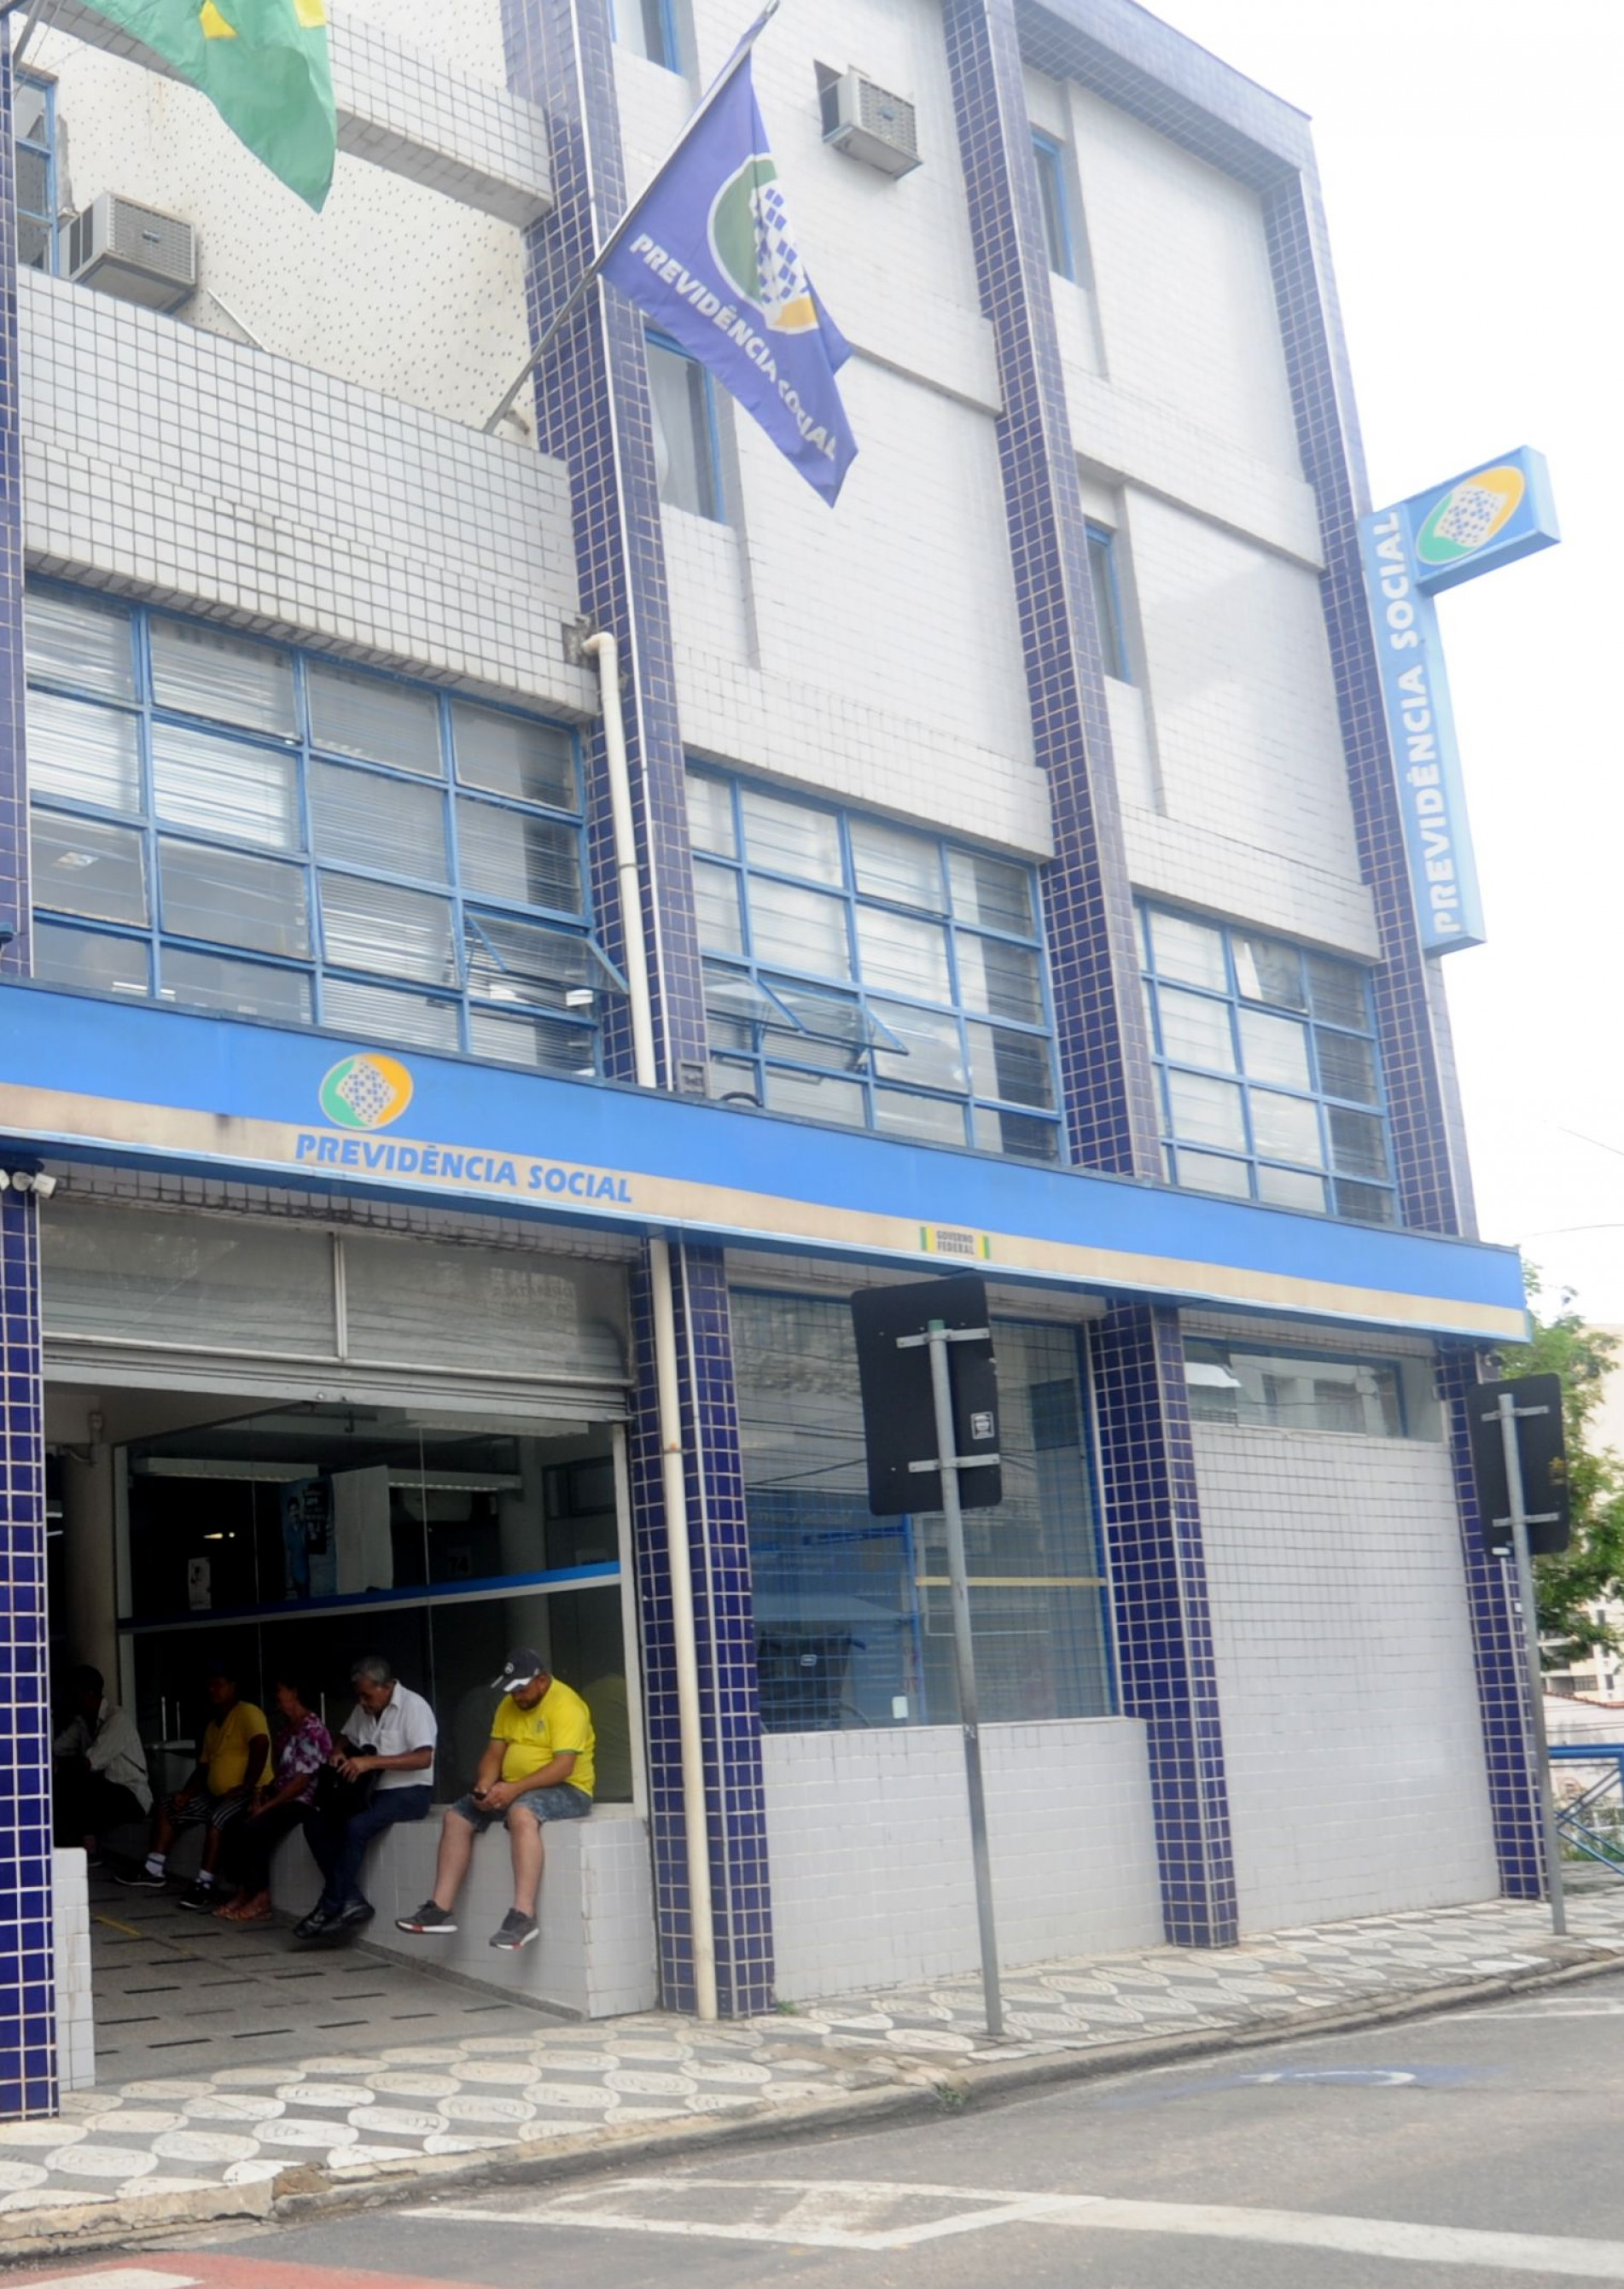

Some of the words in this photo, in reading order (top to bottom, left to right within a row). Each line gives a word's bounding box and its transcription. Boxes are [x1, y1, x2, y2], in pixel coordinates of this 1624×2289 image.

[629, 234, 777, 383] PREVIDÊNCIA
[1373, 511, 1418, 651] SOCIAL
[1397, 665, 1461, 935] PREVIDÊNCIA
[295, 1133, 516, 1186] PREVIDÊNCIA
[528, 1165, 633, 1203] SOCIAL
[937, 1241, 975, 1255] FEDERAL
